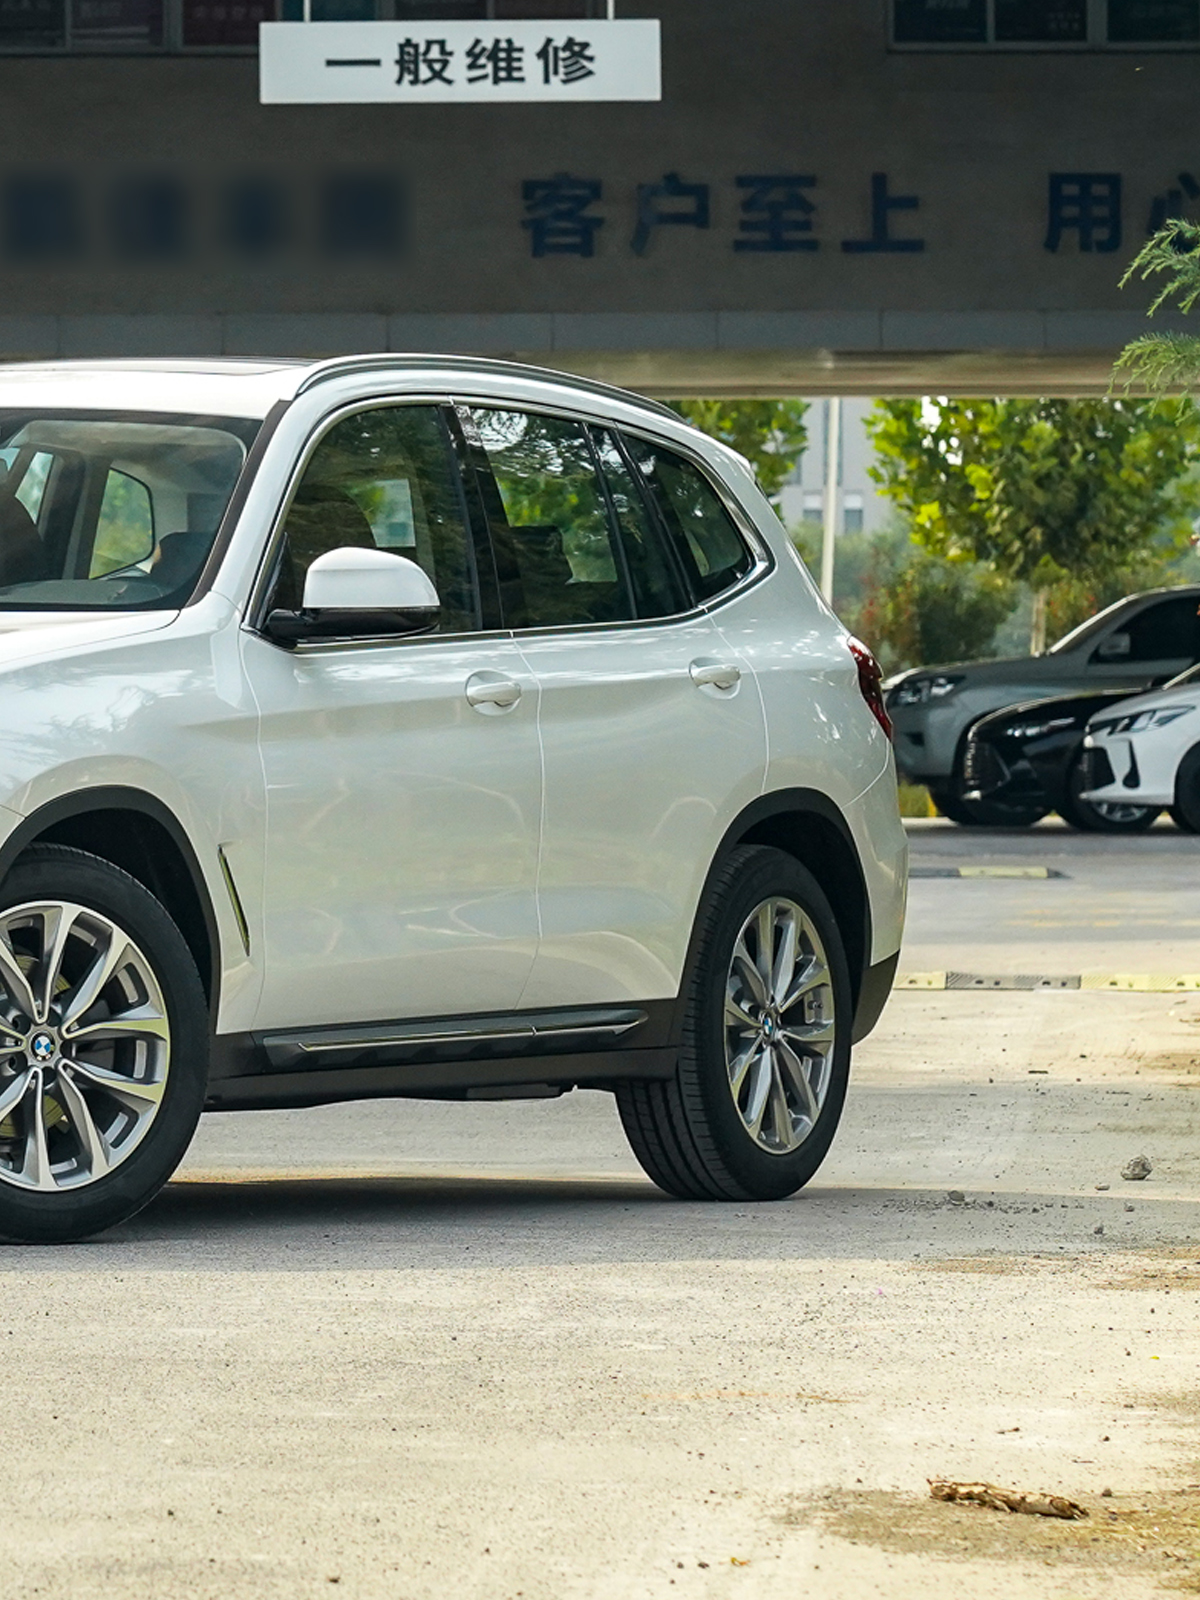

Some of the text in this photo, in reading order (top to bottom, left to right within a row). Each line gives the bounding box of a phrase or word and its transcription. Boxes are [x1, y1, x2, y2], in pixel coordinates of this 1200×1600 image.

[324, 36, 596, 87] 一般维修
[520, 171, 926, 258] 客户至上
